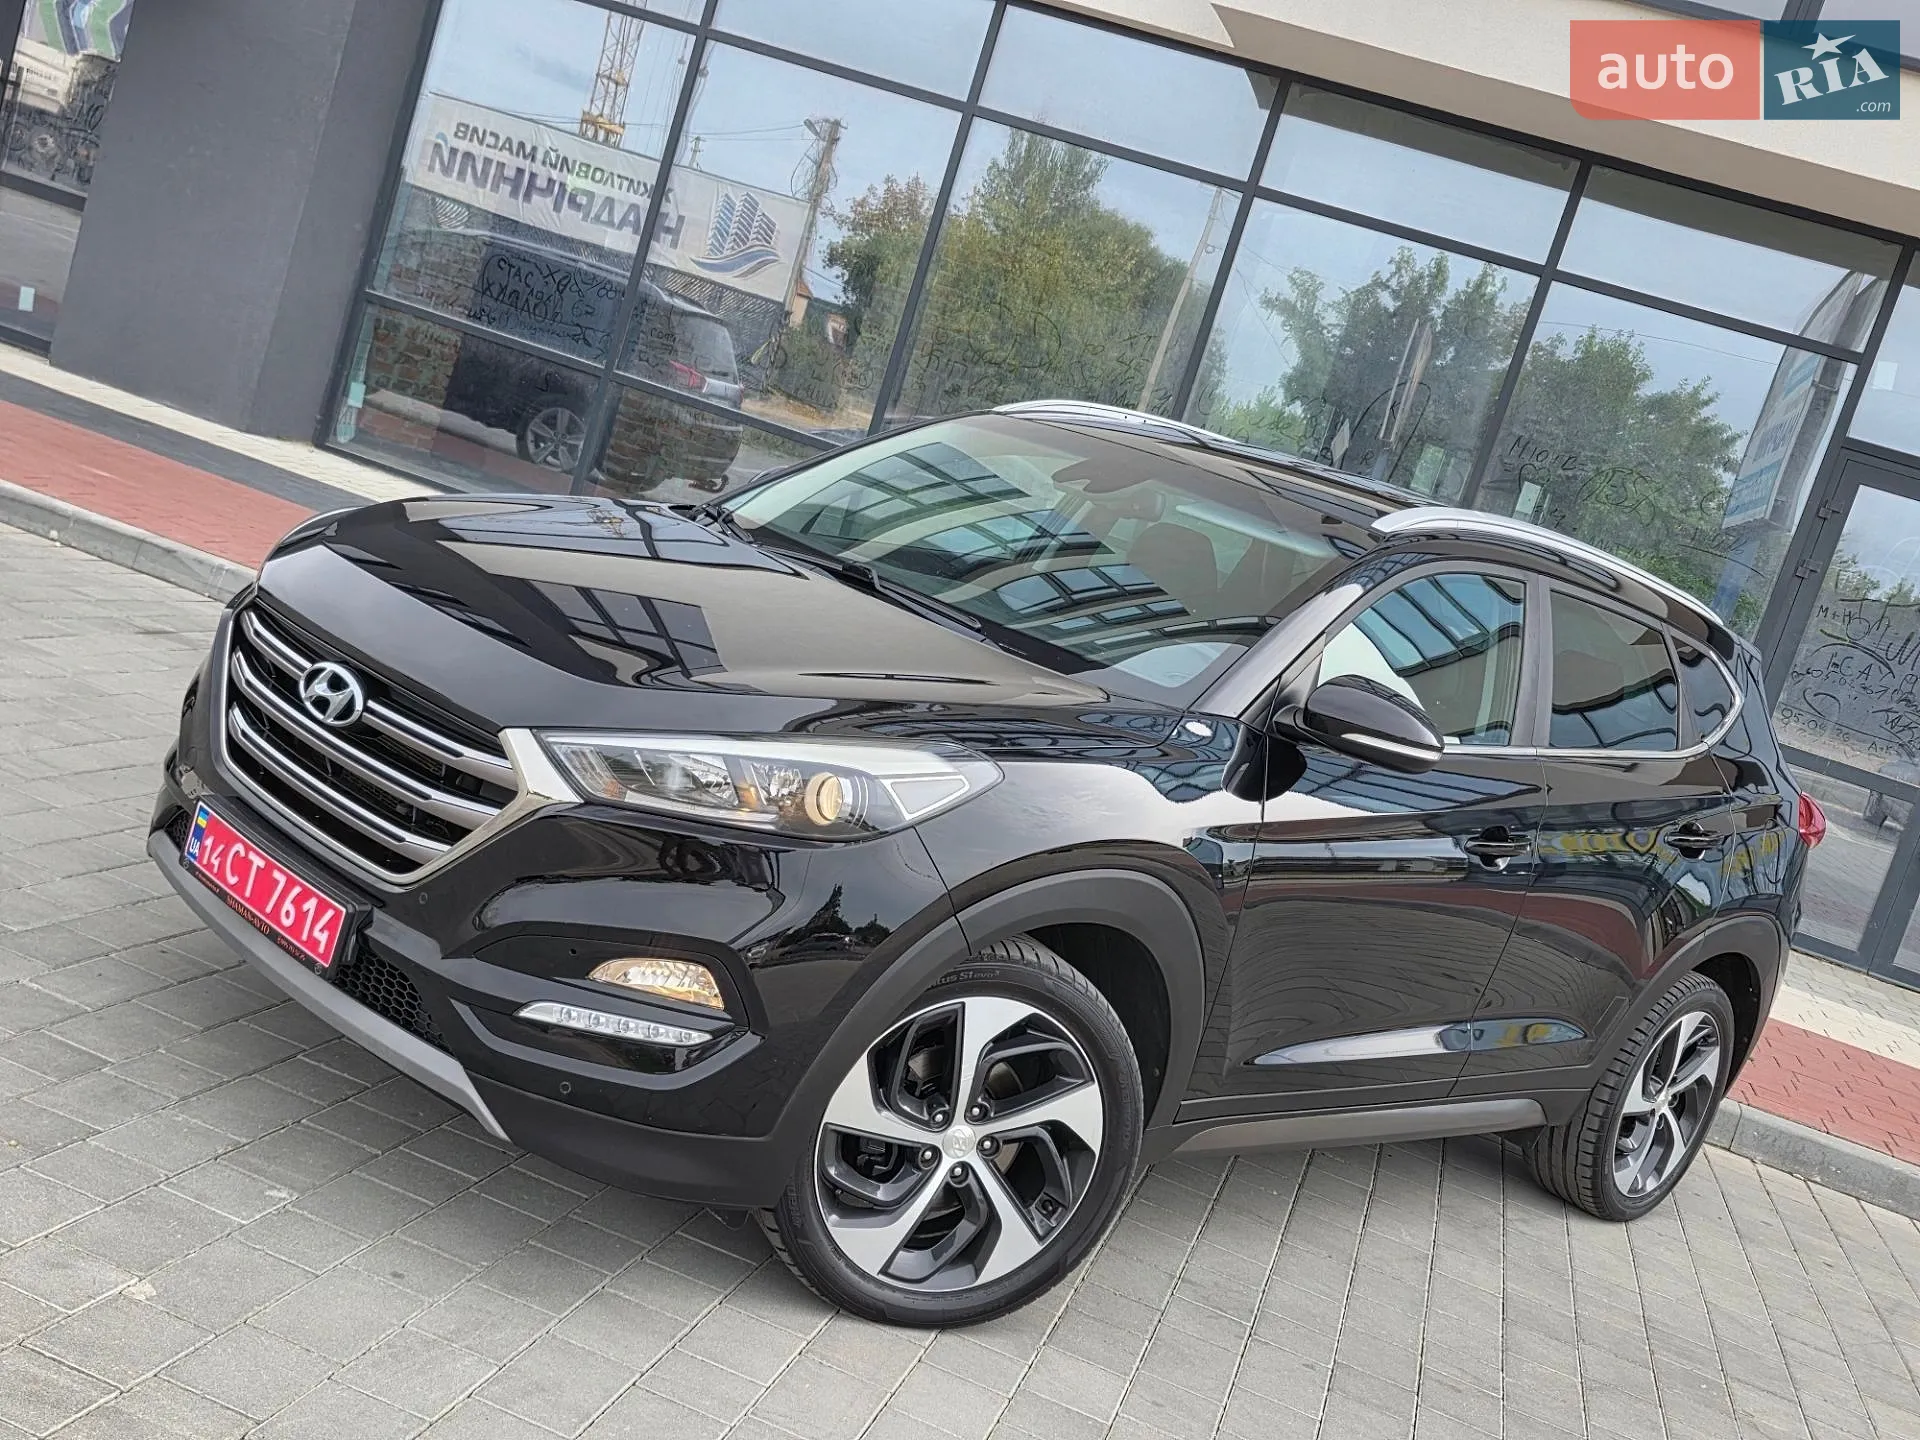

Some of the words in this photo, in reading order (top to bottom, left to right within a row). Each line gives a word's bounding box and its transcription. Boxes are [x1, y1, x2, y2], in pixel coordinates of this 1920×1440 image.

[189, 838, 201, 857] UA
[203, 835, 225, 874] 14
[225, 842, 266, 899] CT
[265, 868, 336, 954] 7614
